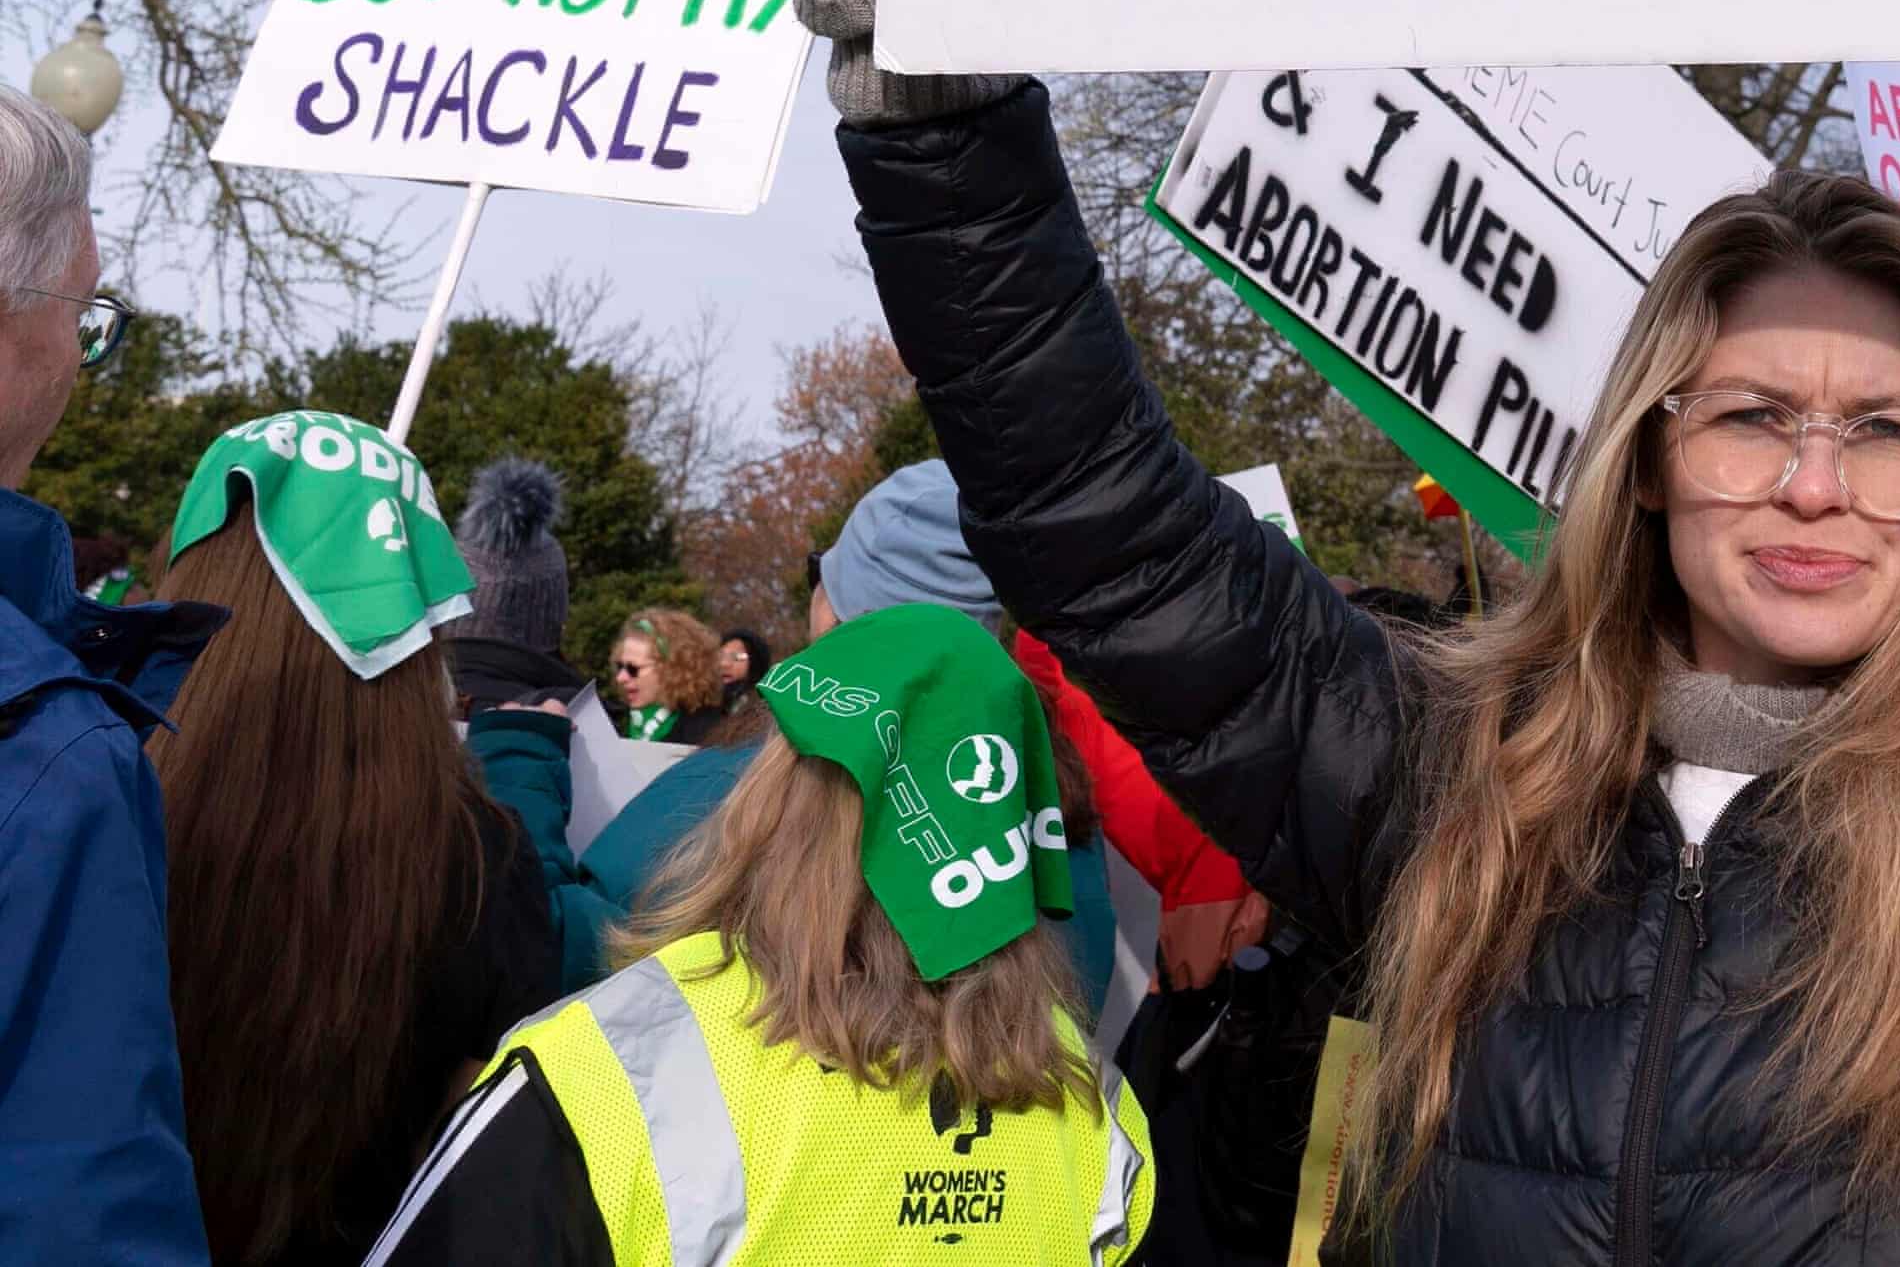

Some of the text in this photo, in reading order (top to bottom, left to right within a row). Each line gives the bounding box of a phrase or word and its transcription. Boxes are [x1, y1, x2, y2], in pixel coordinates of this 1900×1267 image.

[295, 33, 720, 170] SHACKLE
[1464, 66, 1557, 150] EME
[1554, 131, 1633, 230] Court
[1194, 146, 1465, 413] ABORTION
[1345, 93, 1419, 205] I
[1420, 160, 1556, 333] NEED
[898, 1195, 1005, 1228] MARCH
[904, 1170, 1007, 1195] WOMEN'S
